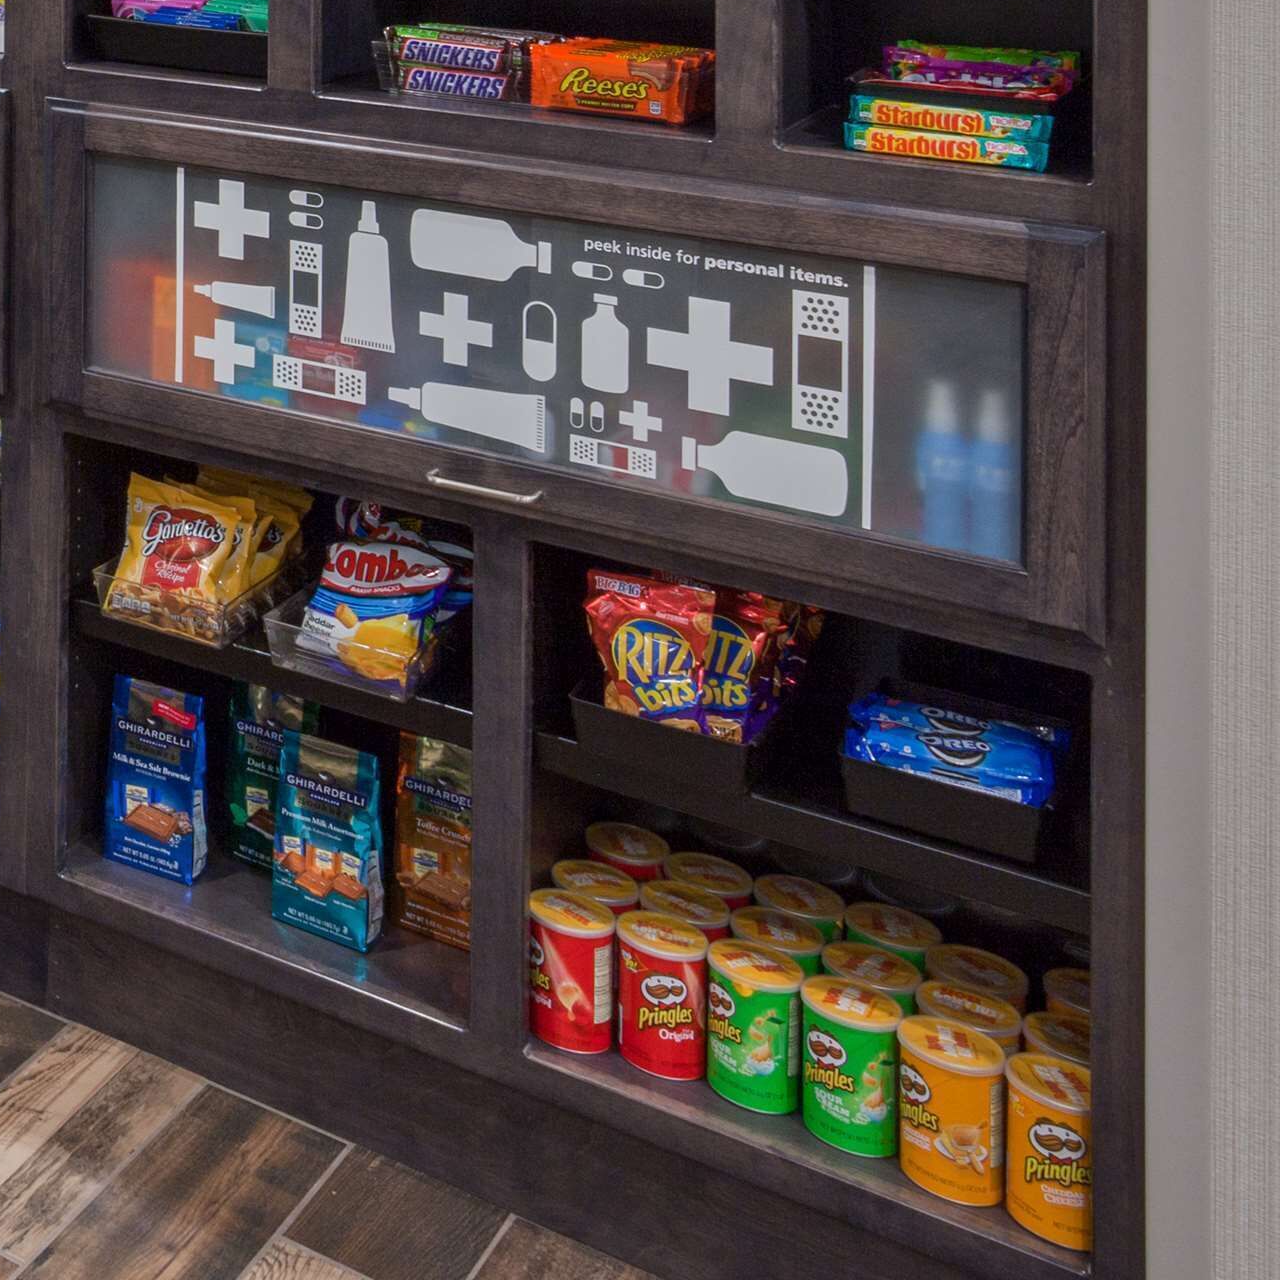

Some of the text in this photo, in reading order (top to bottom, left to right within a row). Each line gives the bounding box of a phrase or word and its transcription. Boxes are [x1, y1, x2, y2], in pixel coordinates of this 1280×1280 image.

[405, 40, 497, 70] SNICKERS
[410, 70, 504, 99] SNICKERS
[560, 68, 649, 98] Reese's
[876, 103, 982, 133] Starburst
[870, 131, 977, 160] Starburst
[584, 238, 848, 287] peek inside for personal items.
[142, 510, 226, 557] Gardetto's
[595, 576, 641, 598] BIG BAG
[618, 625, 689, 684] RITZ
[704, 630, 754, 680] ITZ
[635, 679, 695, 711] bits
[236, 721, 284, 742] GHIRARD
[920, 707, 993, 730] OREO
[118, 720, 190, 748] GHIRARDELLI
[917, 735, 991, 752] OREO
[113, 752, 128, 763] Milk
[135, 759, 148, 769] Sea
[148, 762, 162, 773] Salt
[163, 767, 191, 782] Brownie
[287, 774, 365, 807] GHIRARDELLI
[405, 779, 472, 808] GHIRARDEL
[311, 817, 327, 828] Milk
[416, 818, 440, 832] Toffee
[639, 1006, 694, 1029] Pringles
[710, 1019, 741, 1044] ingles
[659, 1029, 694, 1042] Original
[805, 1063, 855, 1092] Pringles
[901, 1100, 938, 1132] ingles
[1025, 1158, 1091, 1186] Pringles
